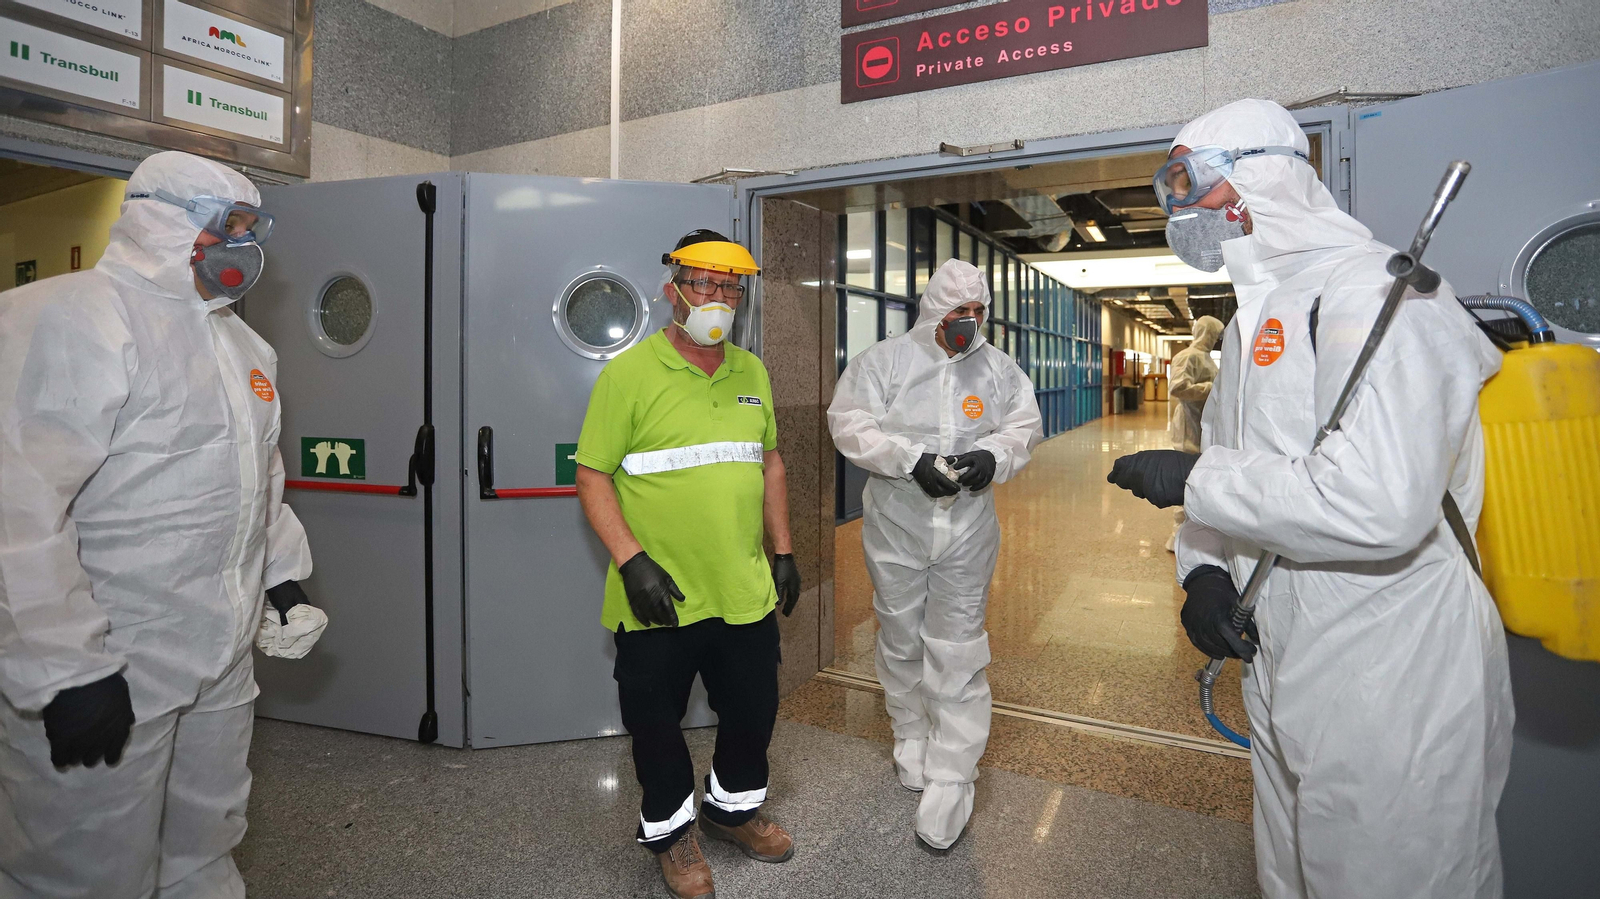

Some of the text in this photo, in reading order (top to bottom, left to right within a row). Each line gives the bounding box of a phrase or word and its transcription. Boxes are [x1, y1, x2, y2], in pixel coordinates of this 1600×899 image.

[182, 35, 212, 49] AFRICA
[214, 45, 252, 61] MOROCCO
[916, 16, 1031, 52] Acceso
[40, 51, 119, 82] Transbull
[916, 41, 1073, 77] Private Access
[122, 98, 137, 107] F-18
[209, 97, 268, 121] Transbull
